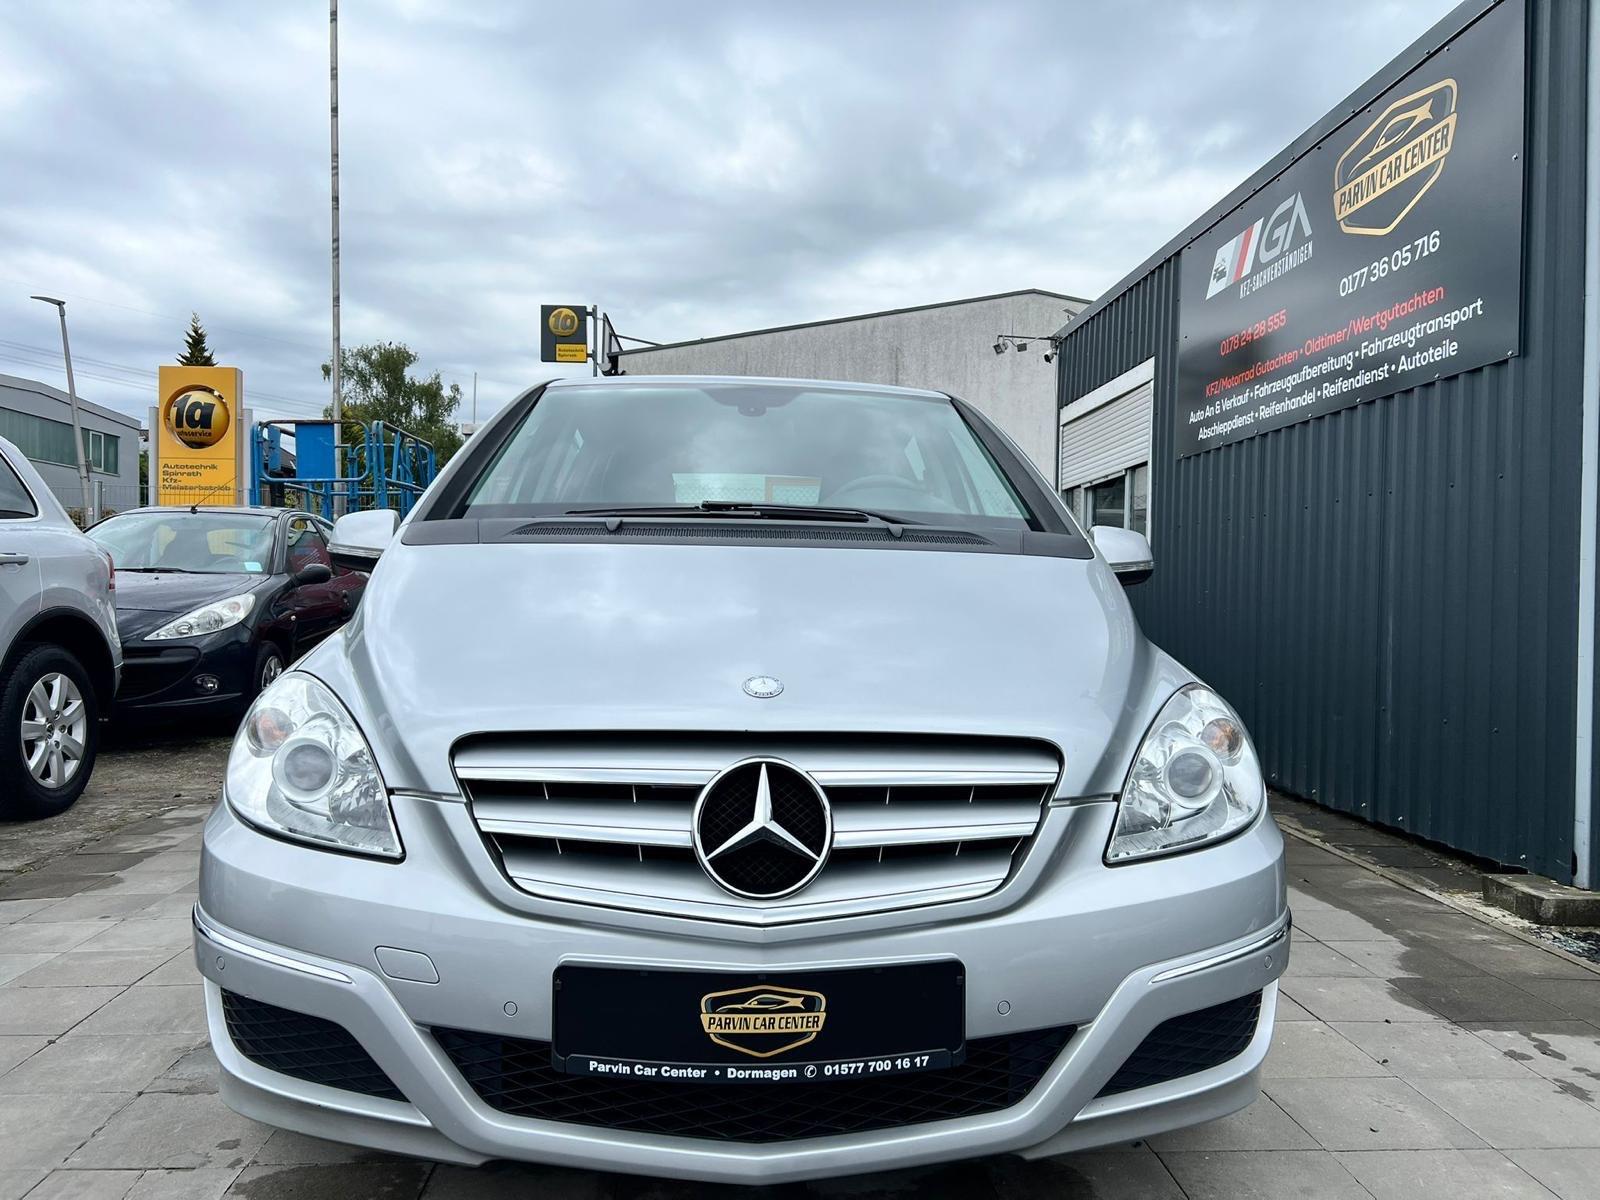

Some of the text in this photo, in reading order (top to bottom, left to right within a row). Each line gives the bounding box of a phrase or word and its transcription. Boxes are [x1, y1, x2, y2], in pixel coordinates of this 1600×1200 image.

[1338, 123, 1450, 215] PARVIN CAR CENTER
[1240, 240, 1313, 299] KFZ-SACHVERSTÄNDIGEN
[1339, 230, 1440, 297] 0177 36 05 716
[1189, 409, 1204, 424] Auto
[1204, 404, 1215, 419] An
[1221, 388, 1250, 412] Verkauf
[1254, 351, 1354, 399] Fahrzeugaufbereitung
[1361, 297, 1483, 360] Fahrzeugtransport
[1205, 286, 1444, 398] KFZ/Motorrad Gutachten Oldtimer/Wertgutachten
[1220, 308, 1287, 356] 0178 24 28 555
[173, 394, 216, 429] 1a
[1198, 339, 1458, 440] Abschleppdienst Reifenhandel Reifendienst Autoteile
[708, 1015, 820, 1030] PARVIN CAR CENTER
[589, 1055, 930, 1080] Parvin Car Center Dormagen 01577 700 16 17
